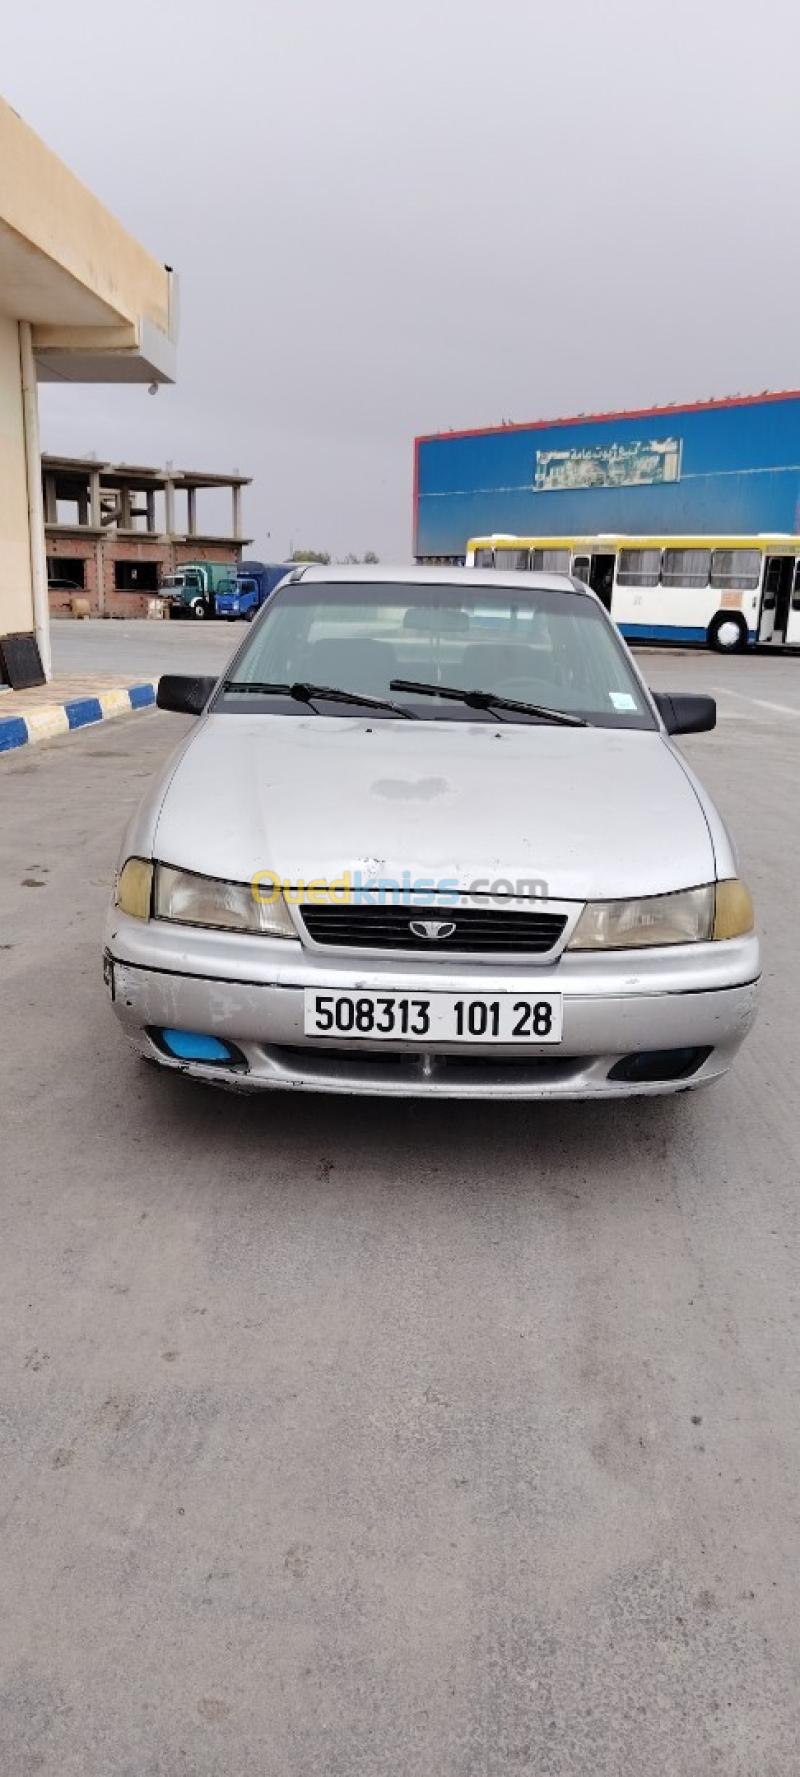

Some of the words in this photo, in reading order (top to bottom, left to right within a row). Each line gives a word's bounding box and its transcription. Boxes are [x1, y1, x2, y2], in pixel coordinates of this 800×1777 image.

[315, 996, 430, 1035] 508313
[454, 1001, 500, 1036] 101
[512, 1001, 552, 1036] 28
